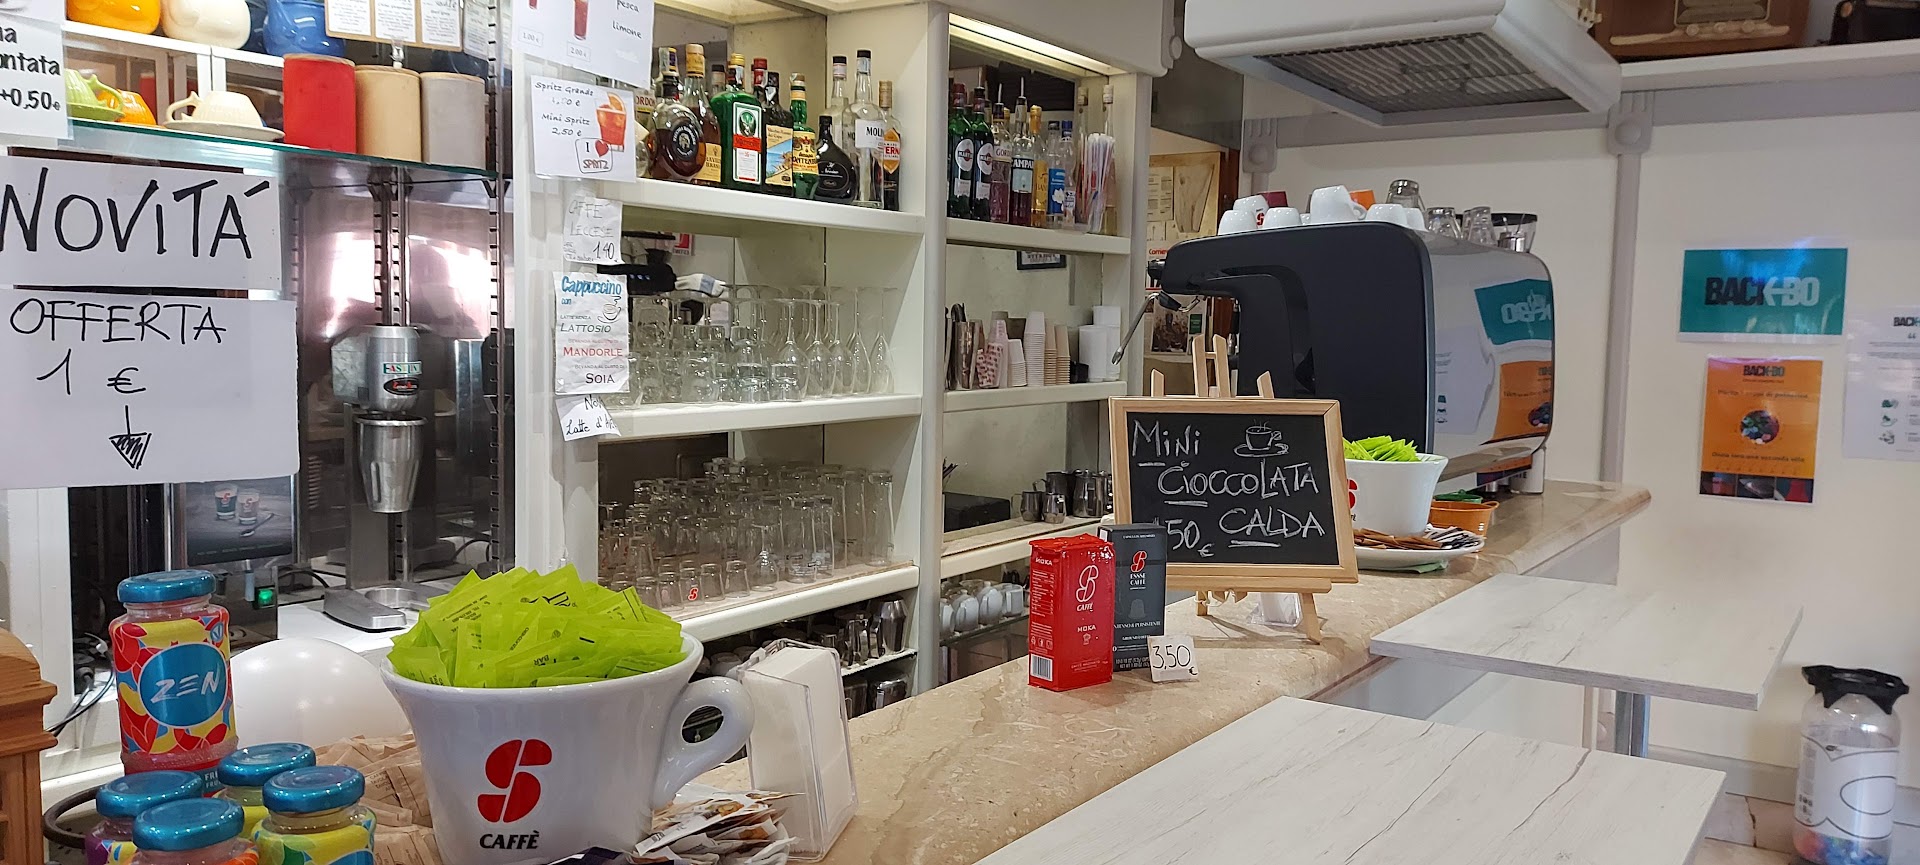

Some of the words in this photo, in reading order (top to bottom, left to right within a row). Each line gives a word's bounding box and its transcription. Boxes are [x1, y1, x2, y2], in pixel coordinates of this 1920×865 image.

[612, 20, 642, 39] limone
[535, 82, 562, 96] Spritz
[583, 159, 609, 170] SPRITZ
[561, 276, 622, 297] Cappuccino
[10, 298, 227, 344] OFFERTA
[560, 323, 612, 333] LATTOSIO
[563, 347, 623, 357] MANDORLE
[36, 349, 73, 395] 1
[585, 373, 615, 384] SOIA
[566, 419, 590, 435] Latte
[1218, 506, 1326, 539] CALDA
[1035, 557, 1053, 566] MOKA
[1077, 625, 1097, 633] MOKA
[151, 665, 220, 704] ZEN
[479, 829, 541, 851] CAFFÈ
